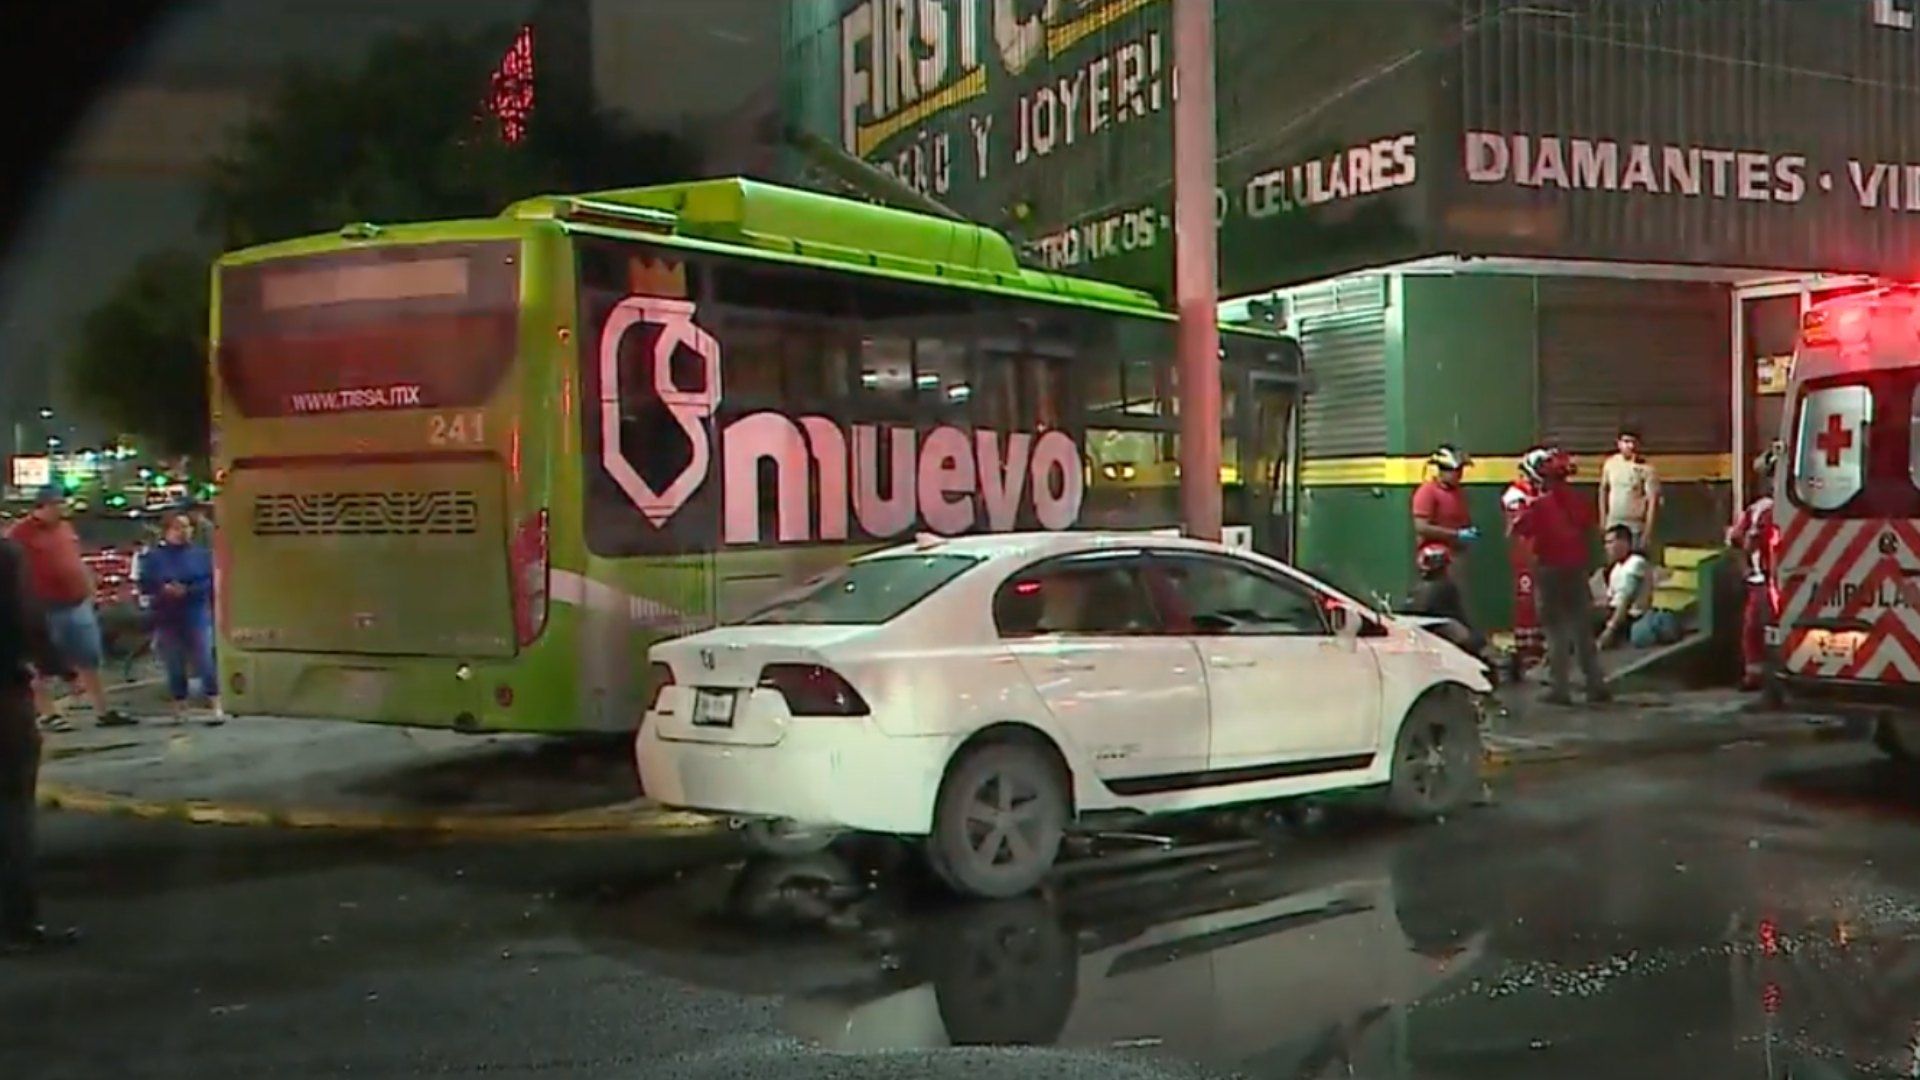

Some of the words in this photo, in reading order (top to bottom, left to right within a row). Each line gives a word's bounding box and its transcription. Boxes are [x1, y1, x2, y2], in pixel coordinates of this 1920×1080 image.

[842, 0, 977, 155] FIRST
[970, 114, 993, 179] Y
[1014, 31, 1180, 164] JOYERI
[1246, 134, 1416, 218] CELULARES
[1464, 130, 1806, 202] DIAMANTES
[427, 412, 485, 446] 241
[723, 411, 1084, 544] muevo
